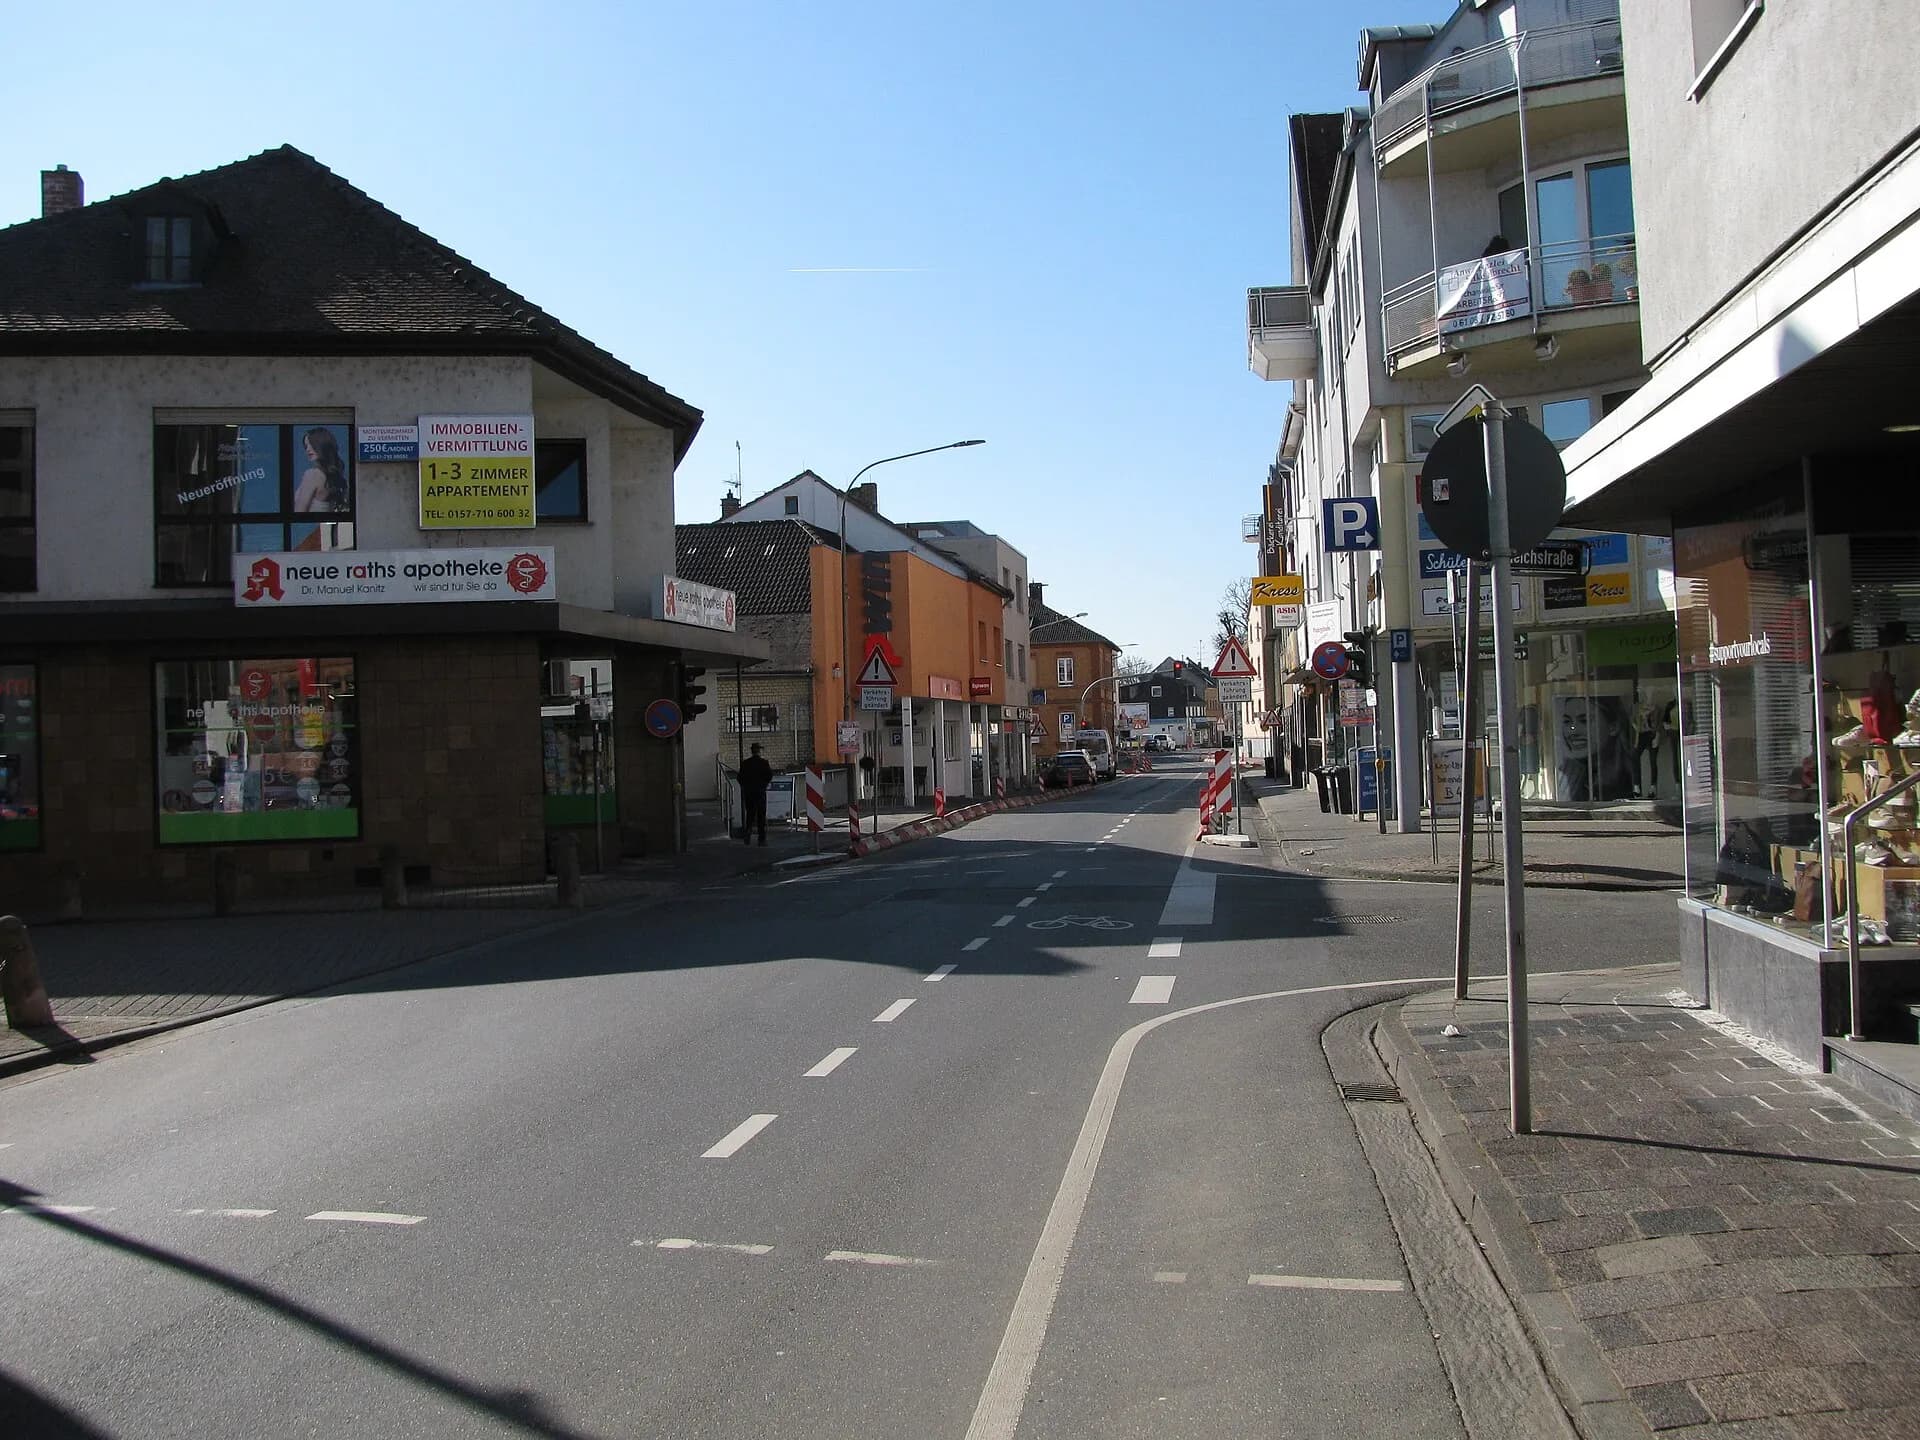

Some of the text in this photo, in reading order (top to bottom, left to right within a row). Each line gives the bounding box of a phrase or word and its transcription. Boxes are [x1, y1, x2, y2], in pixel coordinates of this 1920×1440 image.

[431, 422, 524, 435] IMMOBILIEN-
[427, 439, 528, 452] VERMITTLUNG
[428, 462, 528, 481] 1-3 ZIMMER
[177, 466, 265, 505] Neueröffnung
[426, 485, 529, 497] APPARTEMENT
[447, 509, 494, 519] 0157-710
[496, 509, 515, 519] 600
[518, 508, 530, 518] 32
[1333, 502, 1368, 547] P
[1510, 548, 1574, 569] eichstraße
[286, 560, 504, 580] neue raths apotheke
[301, 585, 314, 596] Dr.
[317, 583, 354, 595] Manuel
[356, 583, 386, 595] Kanitz
[413, 582, 426, 593] wir
[428, 581, 450, 592] sind
[466, 580, 481, 592] Sie
[482, 580, 497, 591] da
[1254, 582, 1300, 599] Kress
[1589, 582, 1625, 599] Kress
[1709, 631, 1771, 666] #supportyourlocals
[1220, 680, 1248, 688] Verkehrs-
